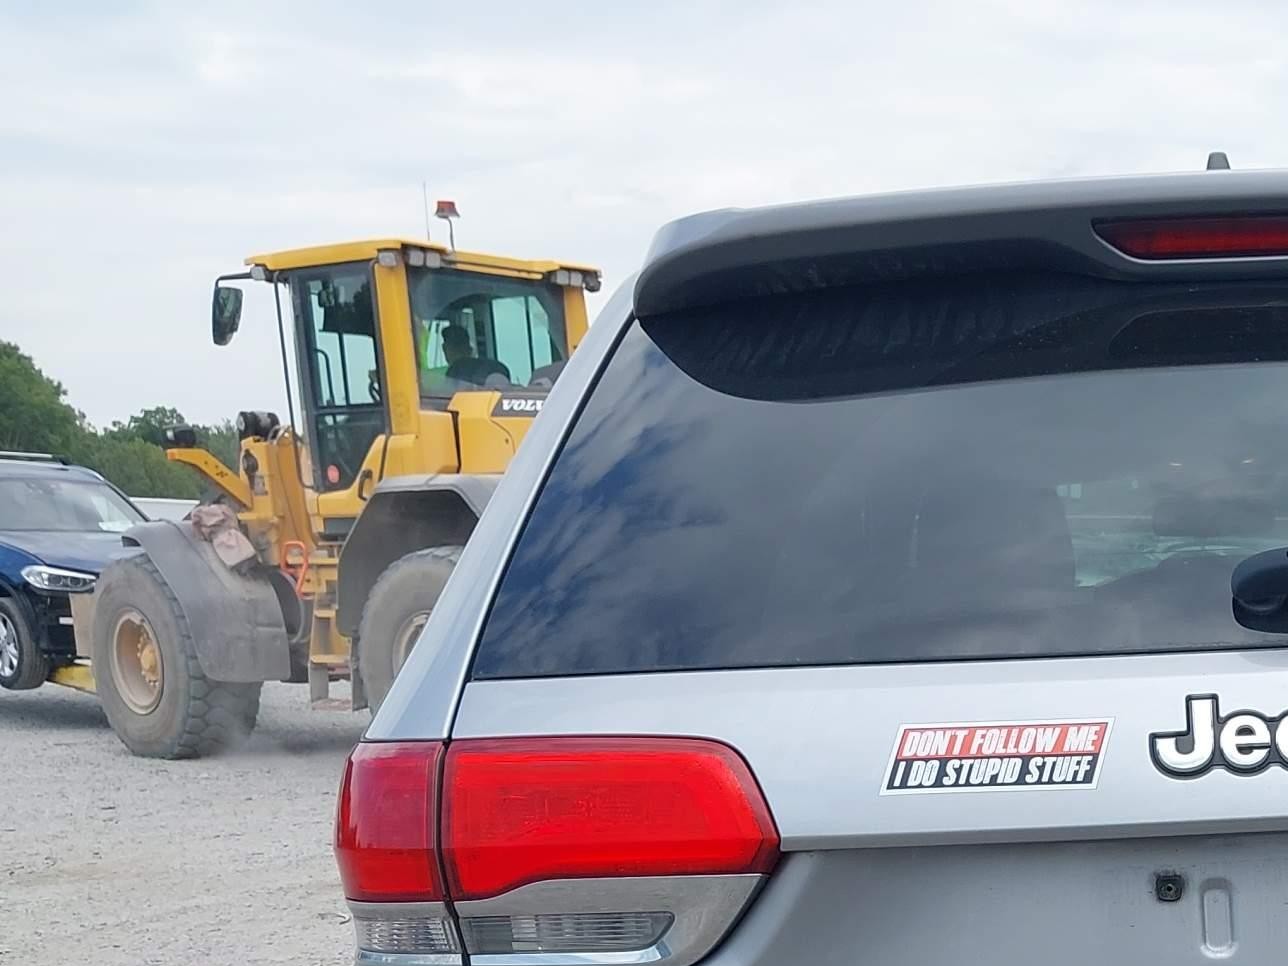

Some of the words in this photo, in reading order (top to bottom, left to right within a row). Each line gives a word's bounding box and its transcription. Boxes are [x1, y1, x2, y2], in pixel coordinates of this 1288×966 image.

[502, 399, 545, 411] VOLV
[901, 729, 968, 757] DON'T
[969, 726, 1060, 755] FOLLOW
[1062, 725, 1100, 751] ME
[893, 761, 906, 787] I
[907, 760, 940, 786] DO
[942, 757, 1022, 785] STUPID
[1025, 756, 1092, 783] STUFF
